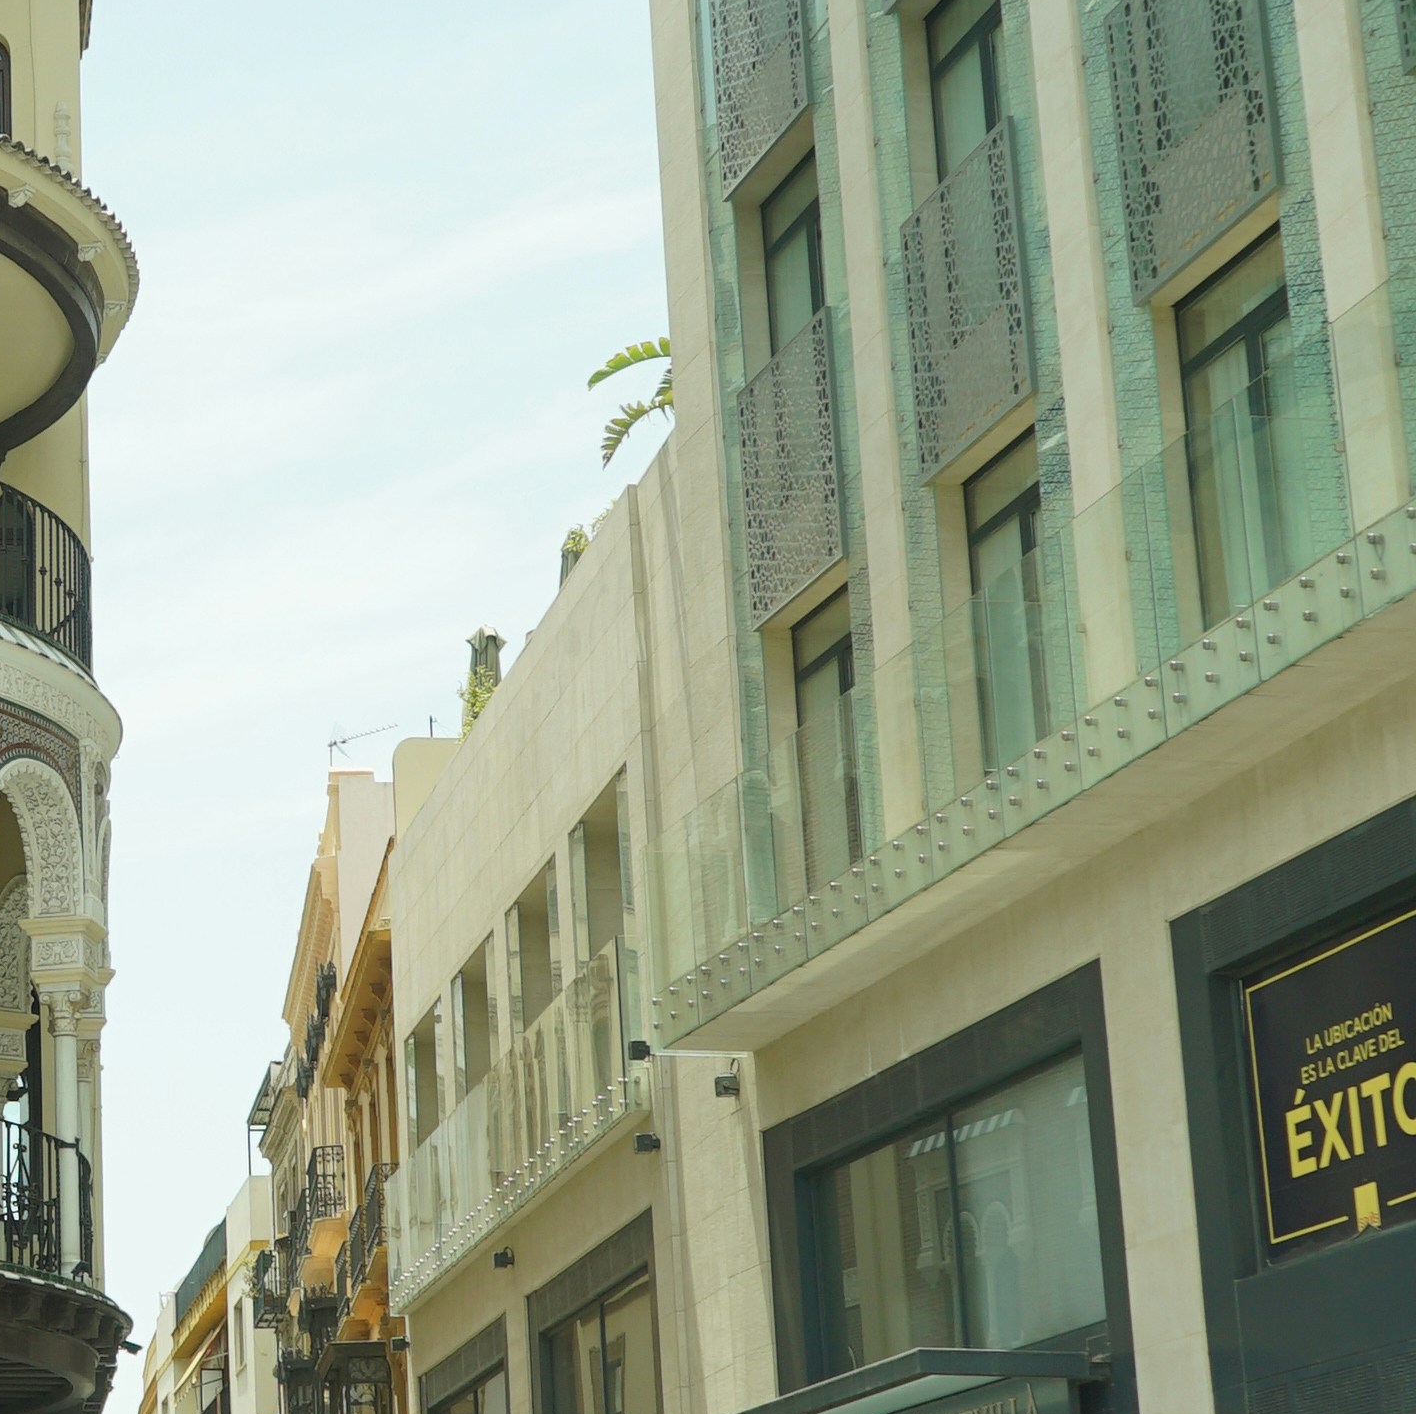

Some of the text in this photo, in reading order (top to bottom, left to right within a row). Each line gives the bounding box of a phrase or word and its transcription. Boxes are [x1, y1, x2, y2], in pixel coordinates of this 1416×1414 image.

[1305, 1002, 1393, 1055] LA UBICACIÓN
[1300, 1028, 1405, 1085] ES LA CLAVE DEL
